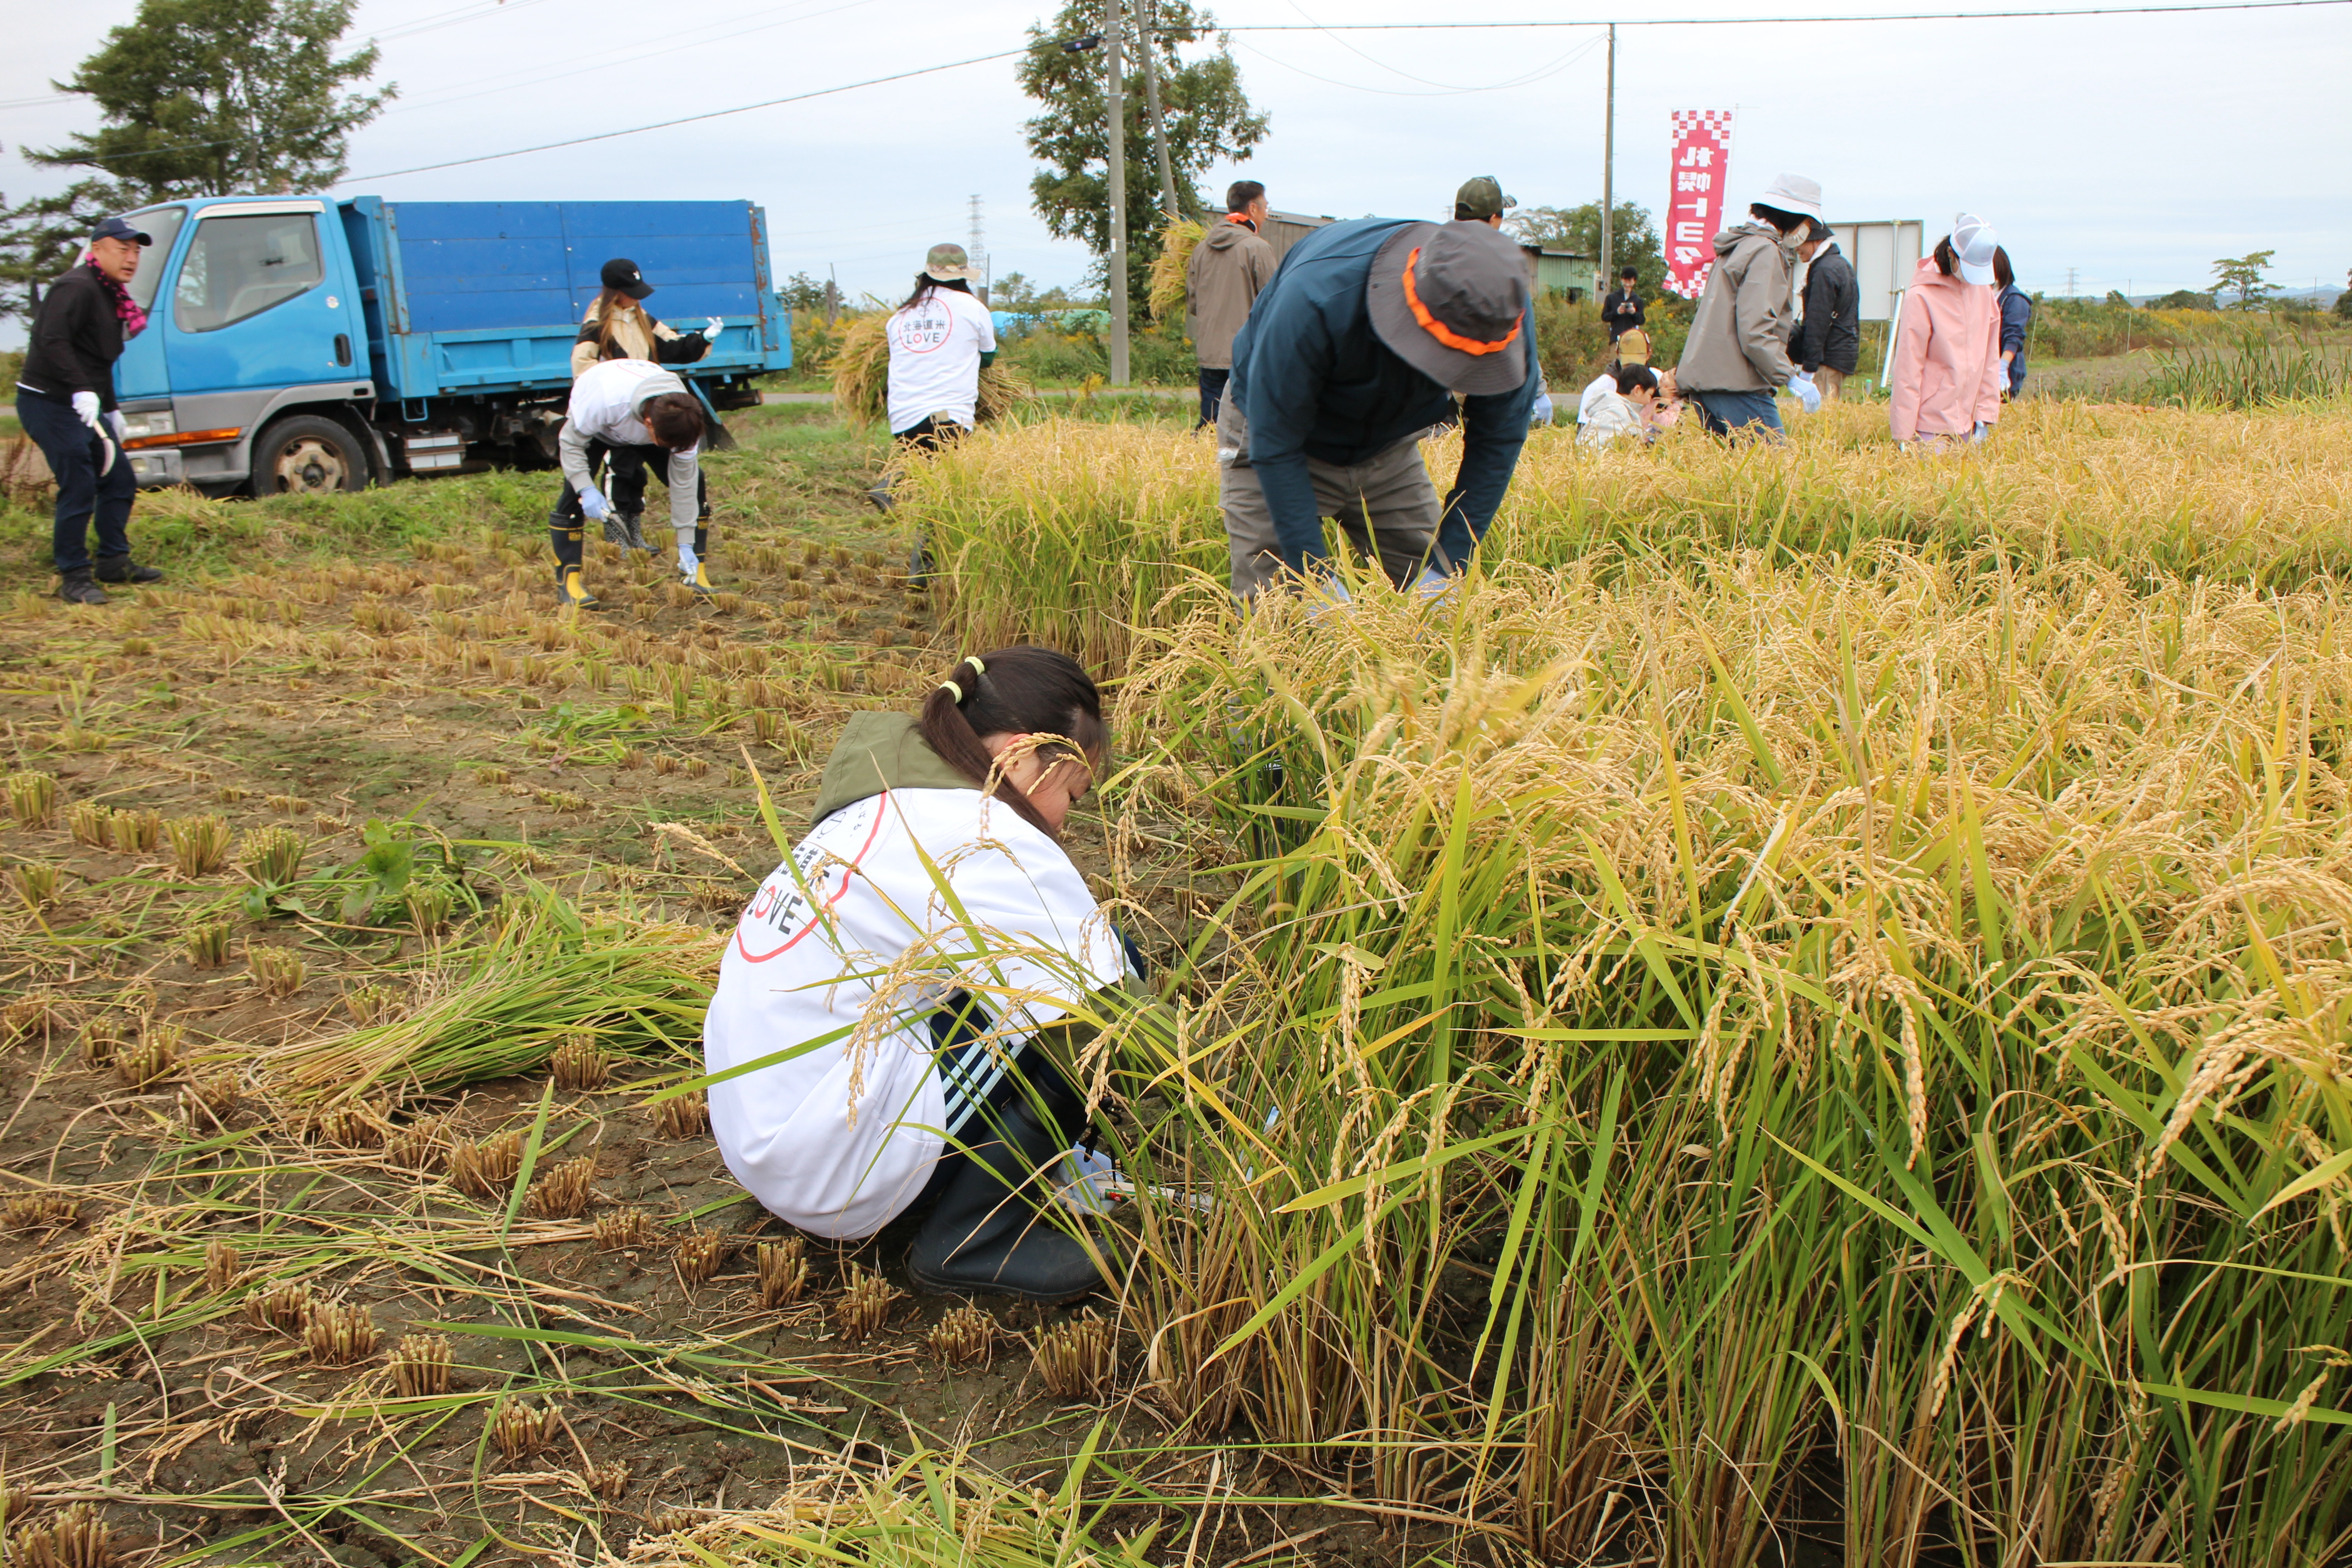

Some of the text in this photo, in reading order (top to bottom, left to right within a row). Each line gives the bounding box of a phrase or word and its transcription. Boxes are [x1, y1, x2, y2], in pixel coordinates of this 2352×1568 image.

[903, 319, 946, 332] 北海道米
[906, 333, 940, 344] LOVE
[747, 882, 803, 935] LOVE
